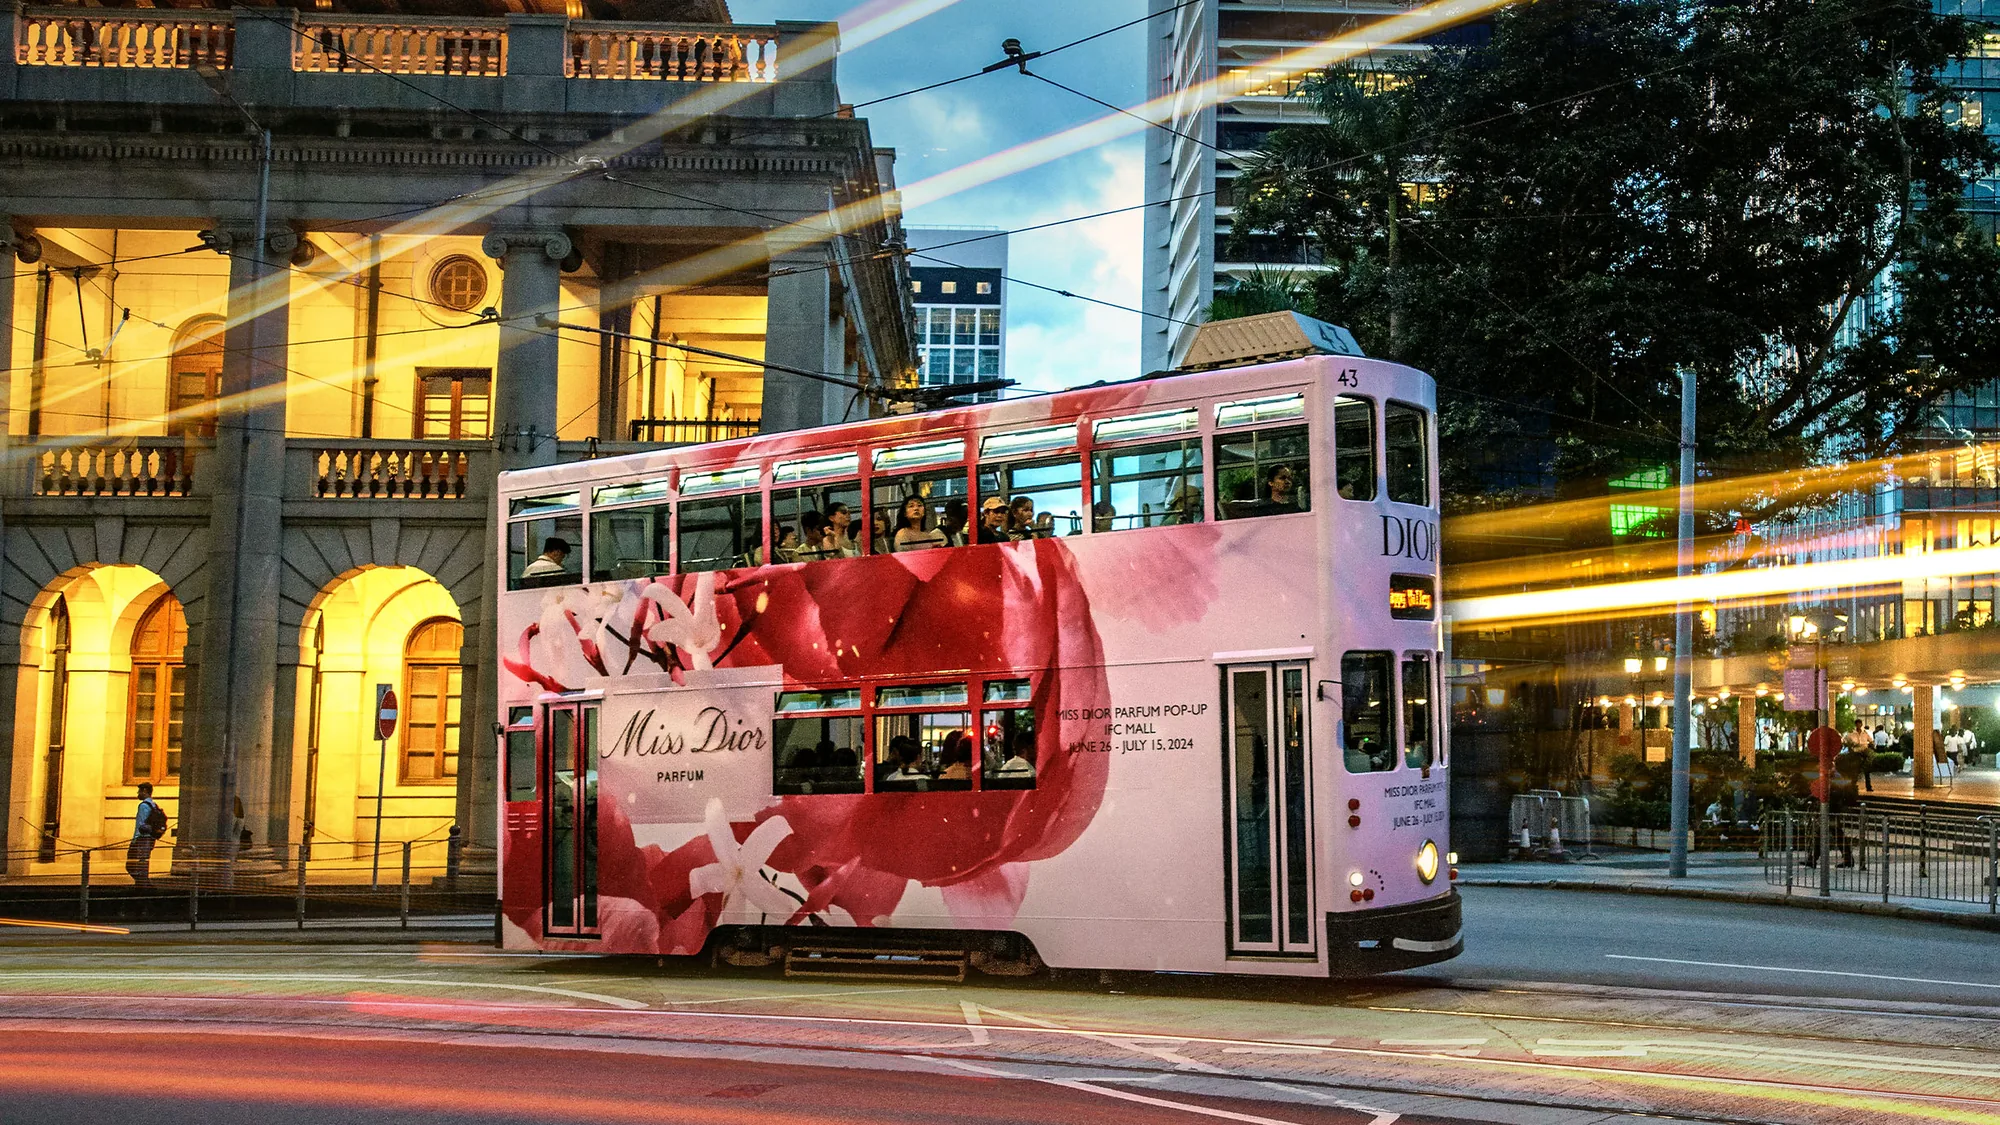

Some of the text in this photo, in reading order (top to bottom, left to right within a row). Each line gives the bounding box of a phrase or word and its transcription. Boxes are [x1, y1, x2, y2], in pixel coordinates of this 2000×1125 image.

[1318, 324, 1350, 354] 43
[1338, 368, 1359, 388] 43
[1380, 514, 1437, 562] DIOR
[1056, 703, 1208, 721] MISS DIOR PARFUM POP-UP
[601, 706, 767, 758] Miss Dior
[1104, 722, 1156, 736] IFC MALL
[1069, 741, 1097, 755] JUNE
[1100, 740, 1112, 752] 26
[1122, 739, 1146, 754] JULY
[1168, 738, 1194, 750] 2024
[657, 770, 704, 782] PARFUM
[1384, 786, 1400, 798] MISS
[1402, 785, 1418, 796] DIOR
[1393, 815, 1411, 830] JUNE
